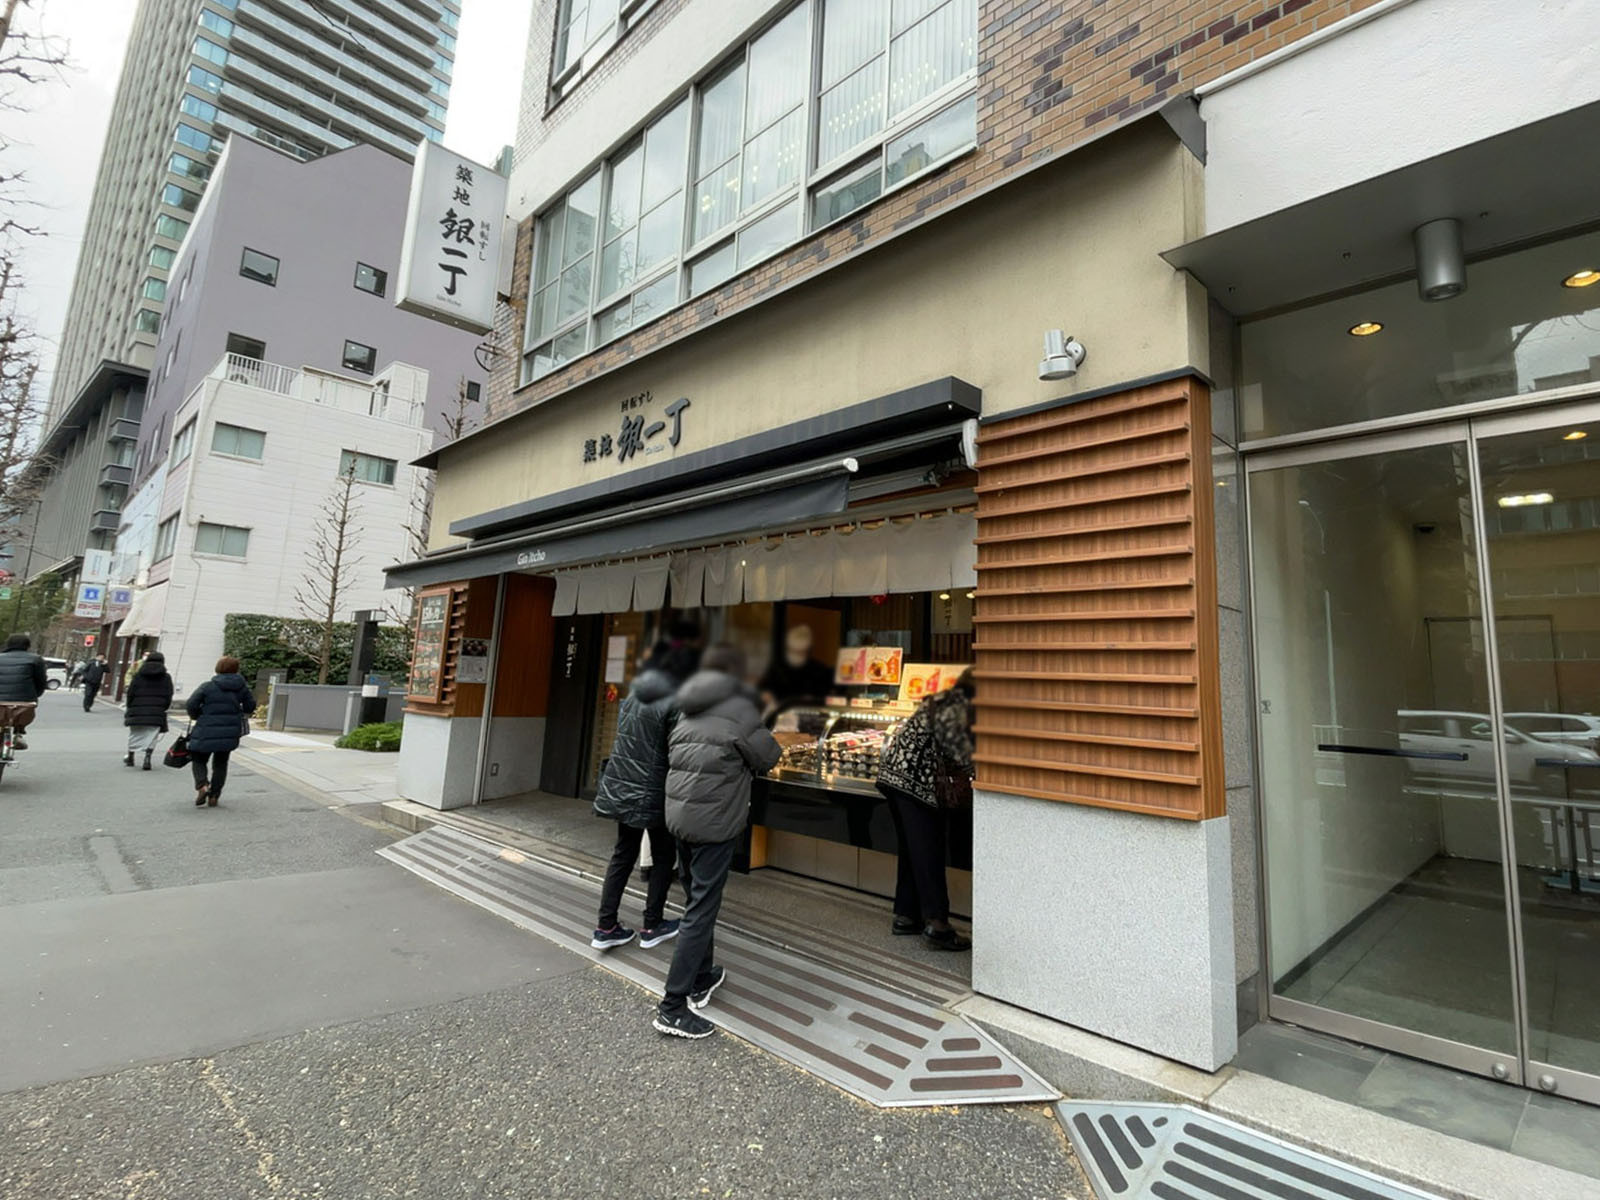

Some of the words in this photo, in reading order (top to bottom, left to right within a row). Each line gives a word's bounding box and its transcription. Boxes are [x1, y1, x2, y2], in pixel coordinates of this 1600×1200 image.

[438, 163, 476, 296] 築地銀一丁
